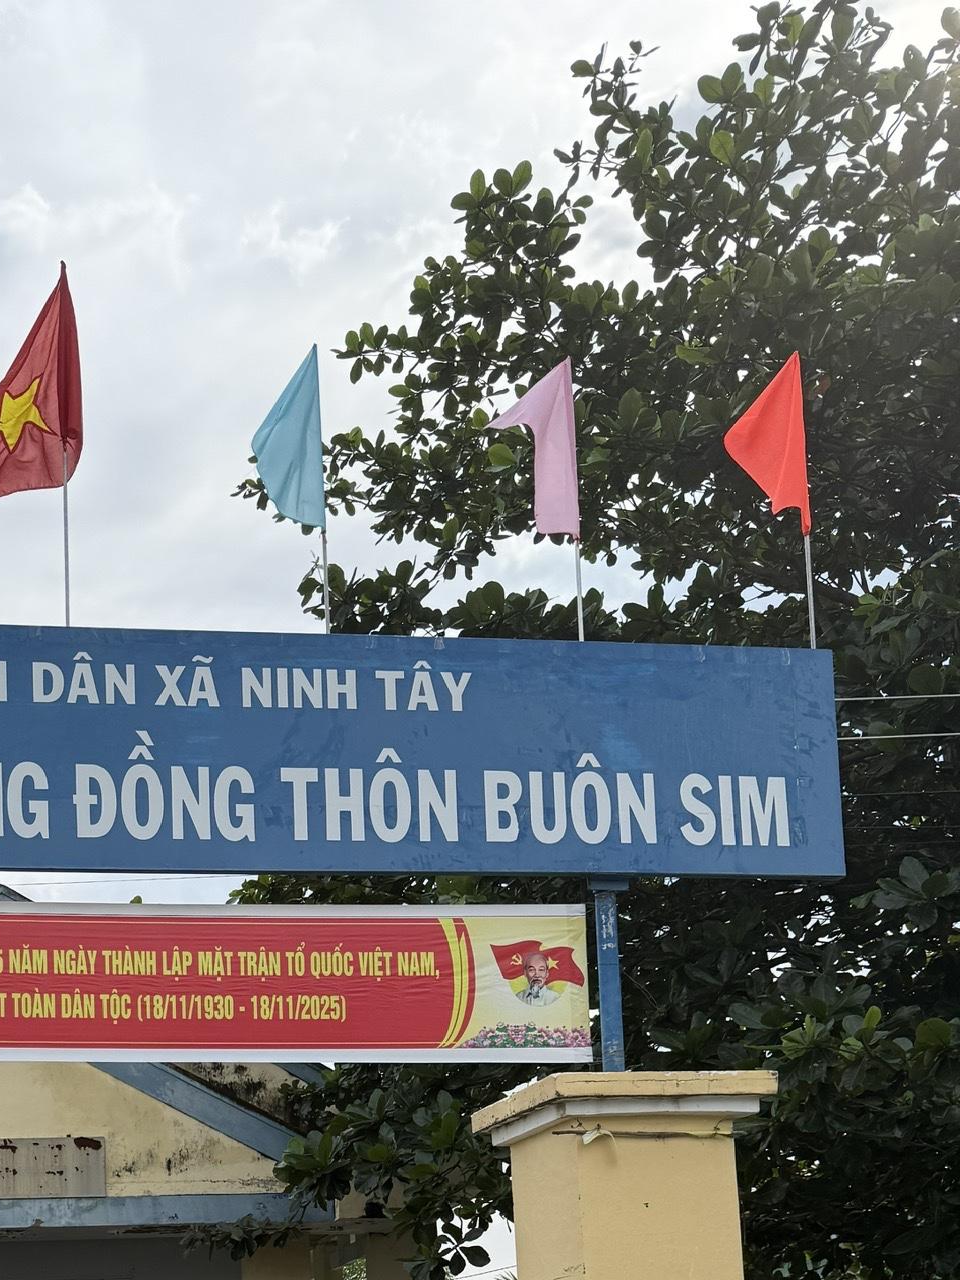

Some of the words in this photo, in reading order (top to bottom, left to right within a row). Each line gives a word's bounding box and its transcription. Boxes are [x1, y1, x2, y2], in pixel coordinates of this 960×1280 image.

[33, 652, 135, 704] DÂN
[155, 656, 219, 707] XÃ
[242, 668, 357, 709] NINH
[375, 661, 471, 711] TÂY
[73, 731, 255, 841] ĐỒNG
[281, 748, 458, 843] THÔN
[484, 753, 657, 844] BUÔN
[680, 773, 790, 846] SIM
[9, 944, 48, 974] NĂM
[53, 945, 97, 975] NGÀY
[102, 945, 156, 975] THÀNH
[163, 946, 192, 981] LẬP
[198, 946, 233, 981] MẶT
[238, 946, 281, 981] TRẬN
[286, 942, 305, 976] TỔ
[310, 943, 353, 977] QUỐC
[358, 947, 392, 981] VIỆT
[398, 952, 439, 979] NAM,
[12, 988, 55, 1018] TOÀN
[61, 988, 95, 1018] DÂN
[100, 989, 131, 1024] TỘC
[138, 994, 234, 1021] (18/11/1930
[251, 995, 346, 1022] 18/11/2025)
